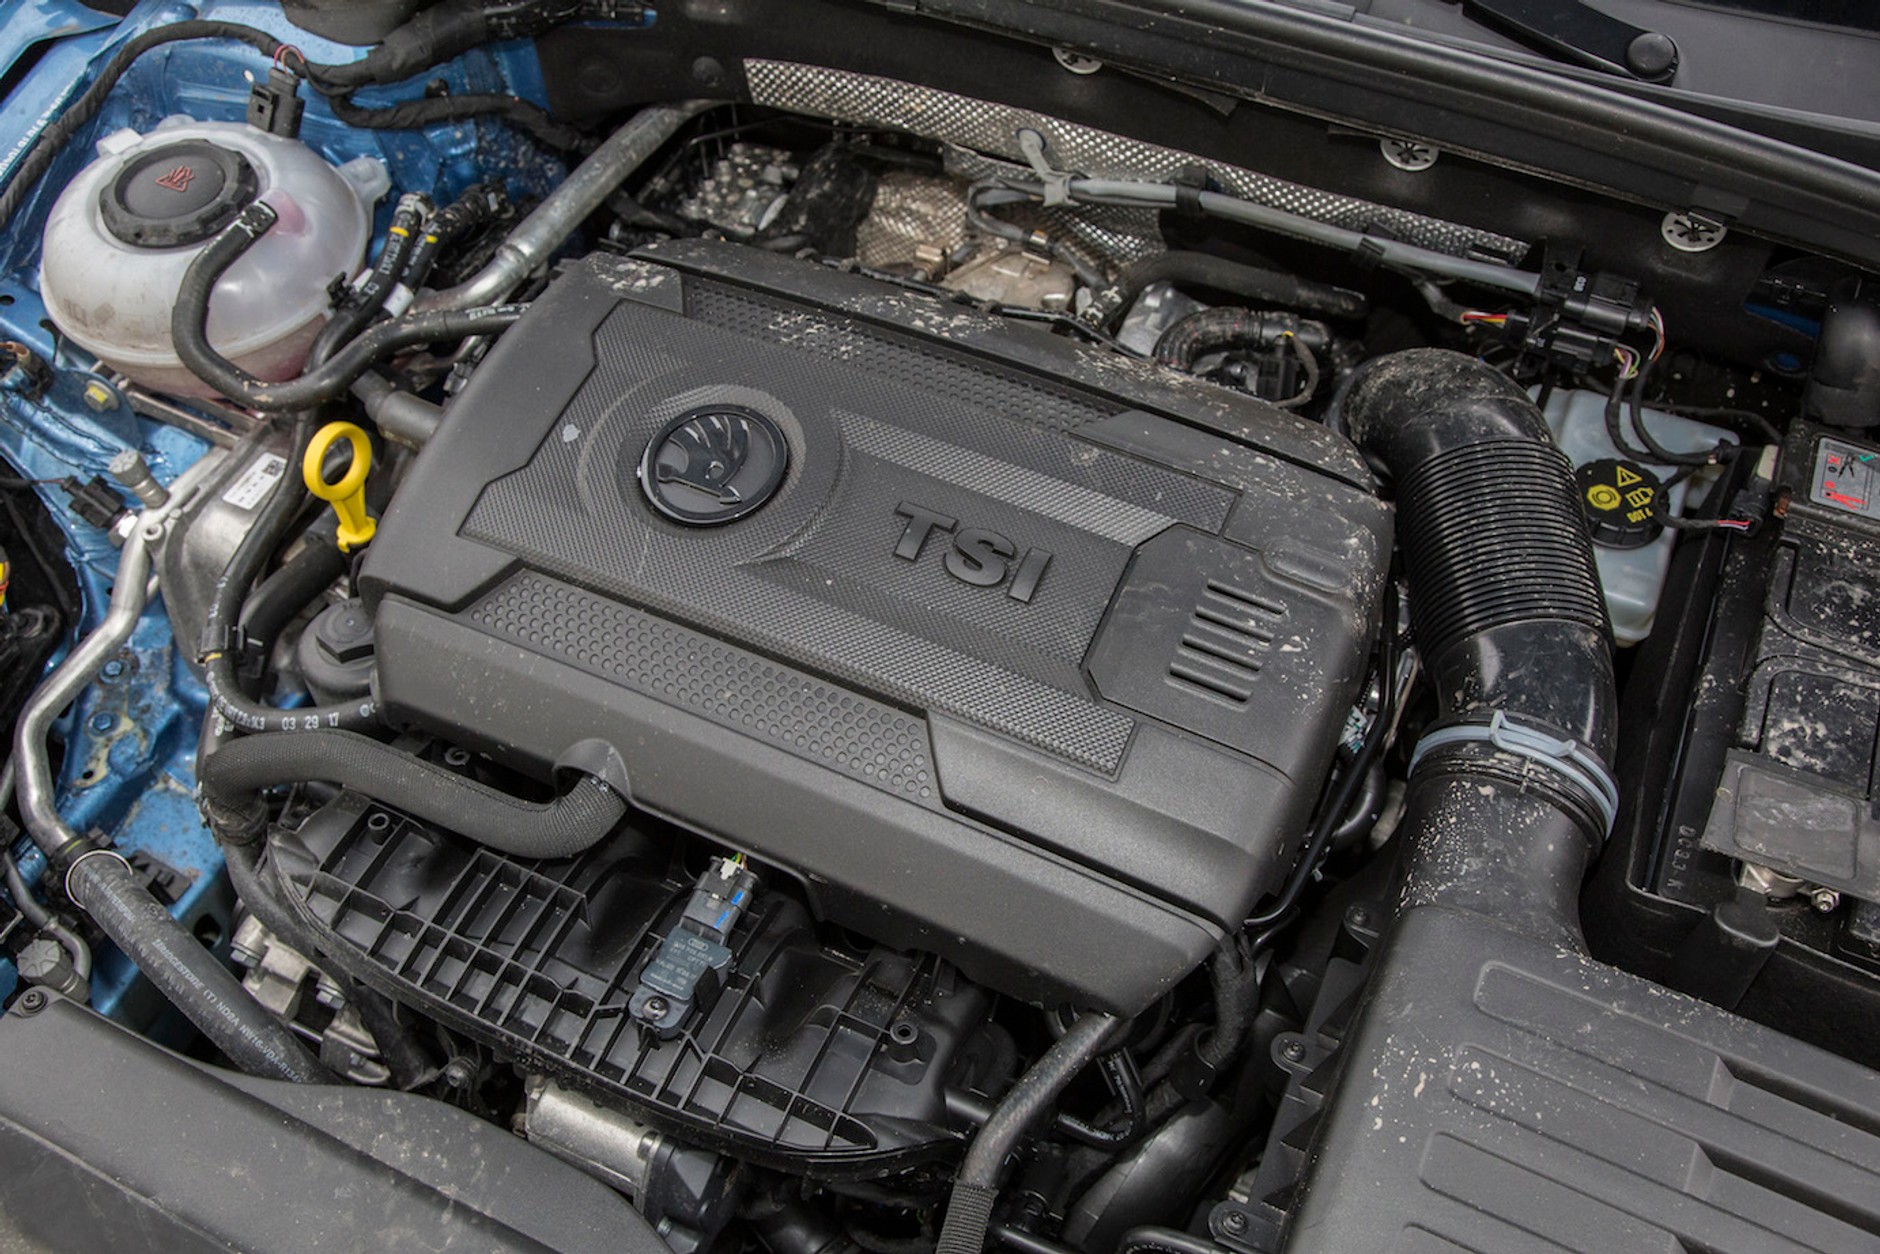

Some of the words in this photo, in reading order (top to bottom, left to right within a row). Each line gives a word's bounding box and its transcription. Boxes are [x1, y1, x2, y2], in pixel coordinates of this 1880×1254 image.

[893, 500, 1053, 605] TSI
[281, 716, 297, 731] 03
[304, 714, 320, 729] 29
[328, 711, 341, 727] 17
[203, 988, 218, 1005] (T)
[216, 1002, 240, 1027] ND2A
